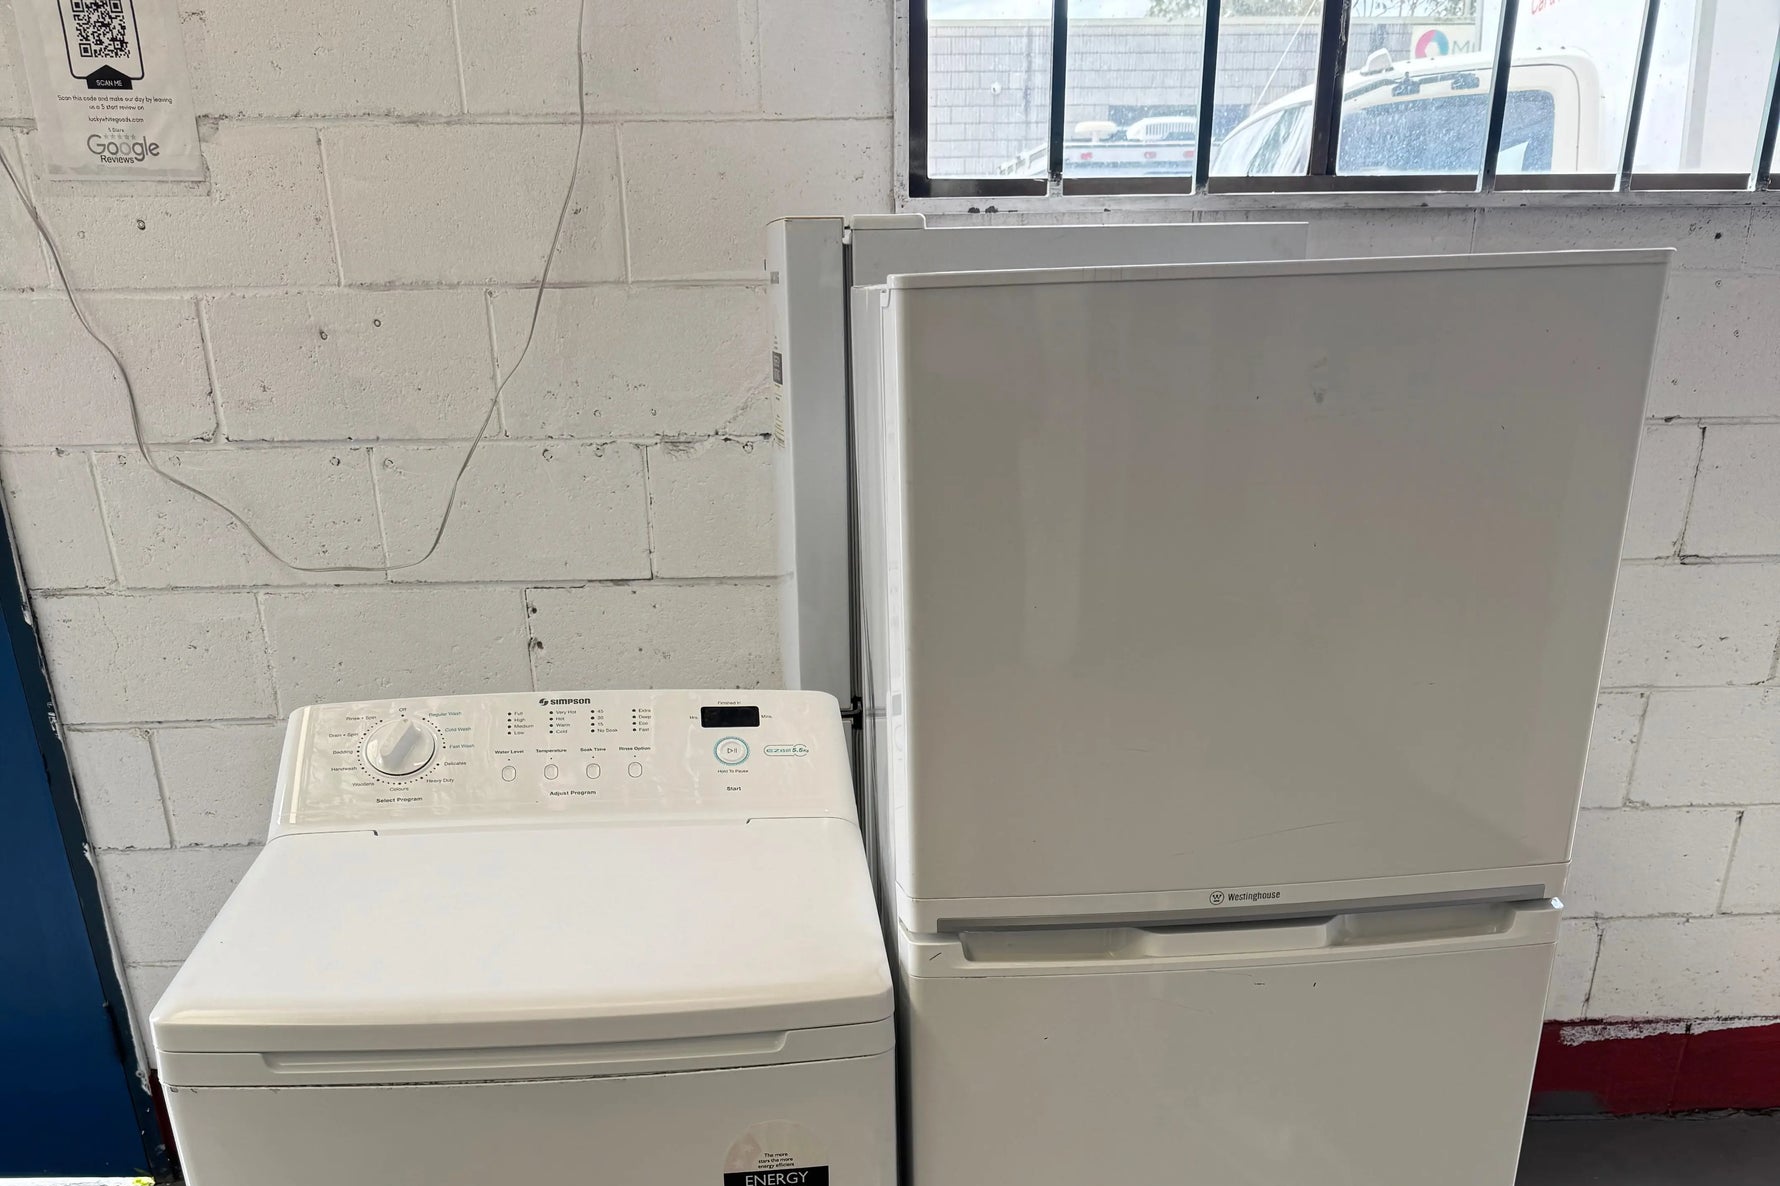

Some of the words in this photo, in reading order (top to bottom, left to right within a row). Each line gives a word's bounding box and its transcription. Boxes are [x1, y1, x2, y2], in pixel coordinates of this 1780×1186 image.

[96, 79, 113, 87] SCAN
[87, 134, 160, 162] Google
[100, 155, 135, 164] Reviews
[397, 796, 423, 804] Program
[1228, 891, 1281, 901] Westinghouse
[745, 1171, 808, 1186] ENERGY
